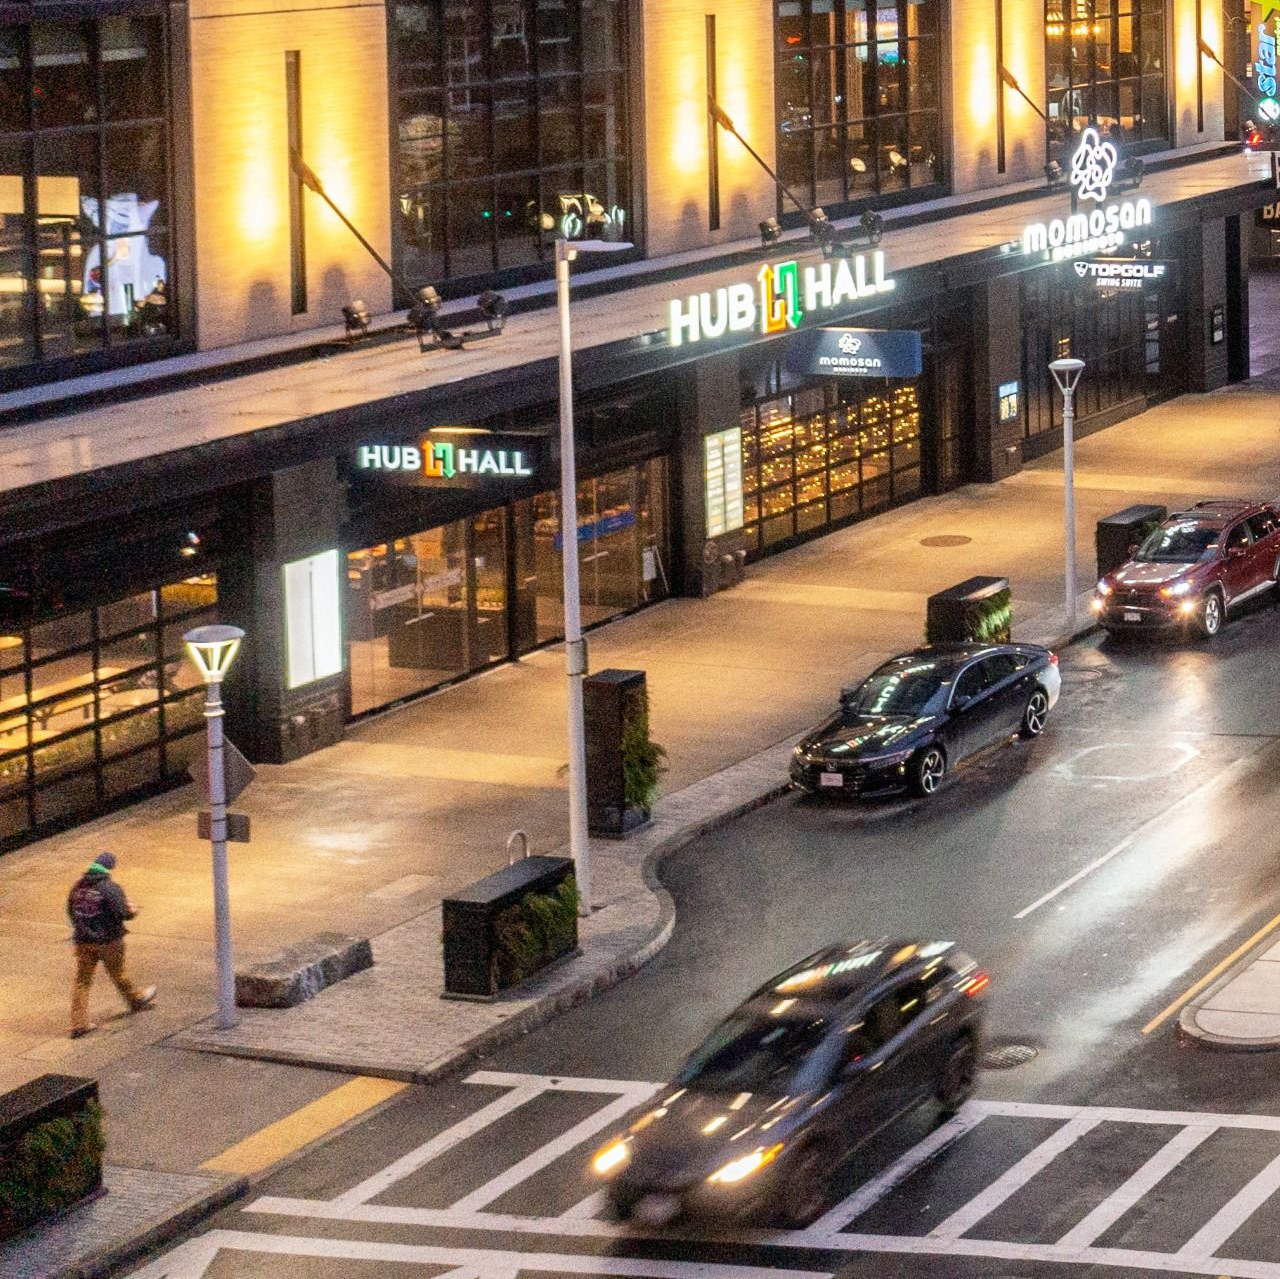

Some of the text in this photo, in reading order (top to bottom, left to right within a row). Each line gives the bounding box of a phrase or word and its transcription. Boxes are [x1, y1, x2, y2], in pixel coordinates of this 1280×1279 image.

[1255, 23, 1277, 97] star
[1022, 198, 1152, 255] momosan
[1088, 264, 1165, 278] TOPGOLF
[670, 250, 896, 347] HUB HALL
[819, 357, 881, 368] momosan
[360, 444, 532, 476] HUB HALL
